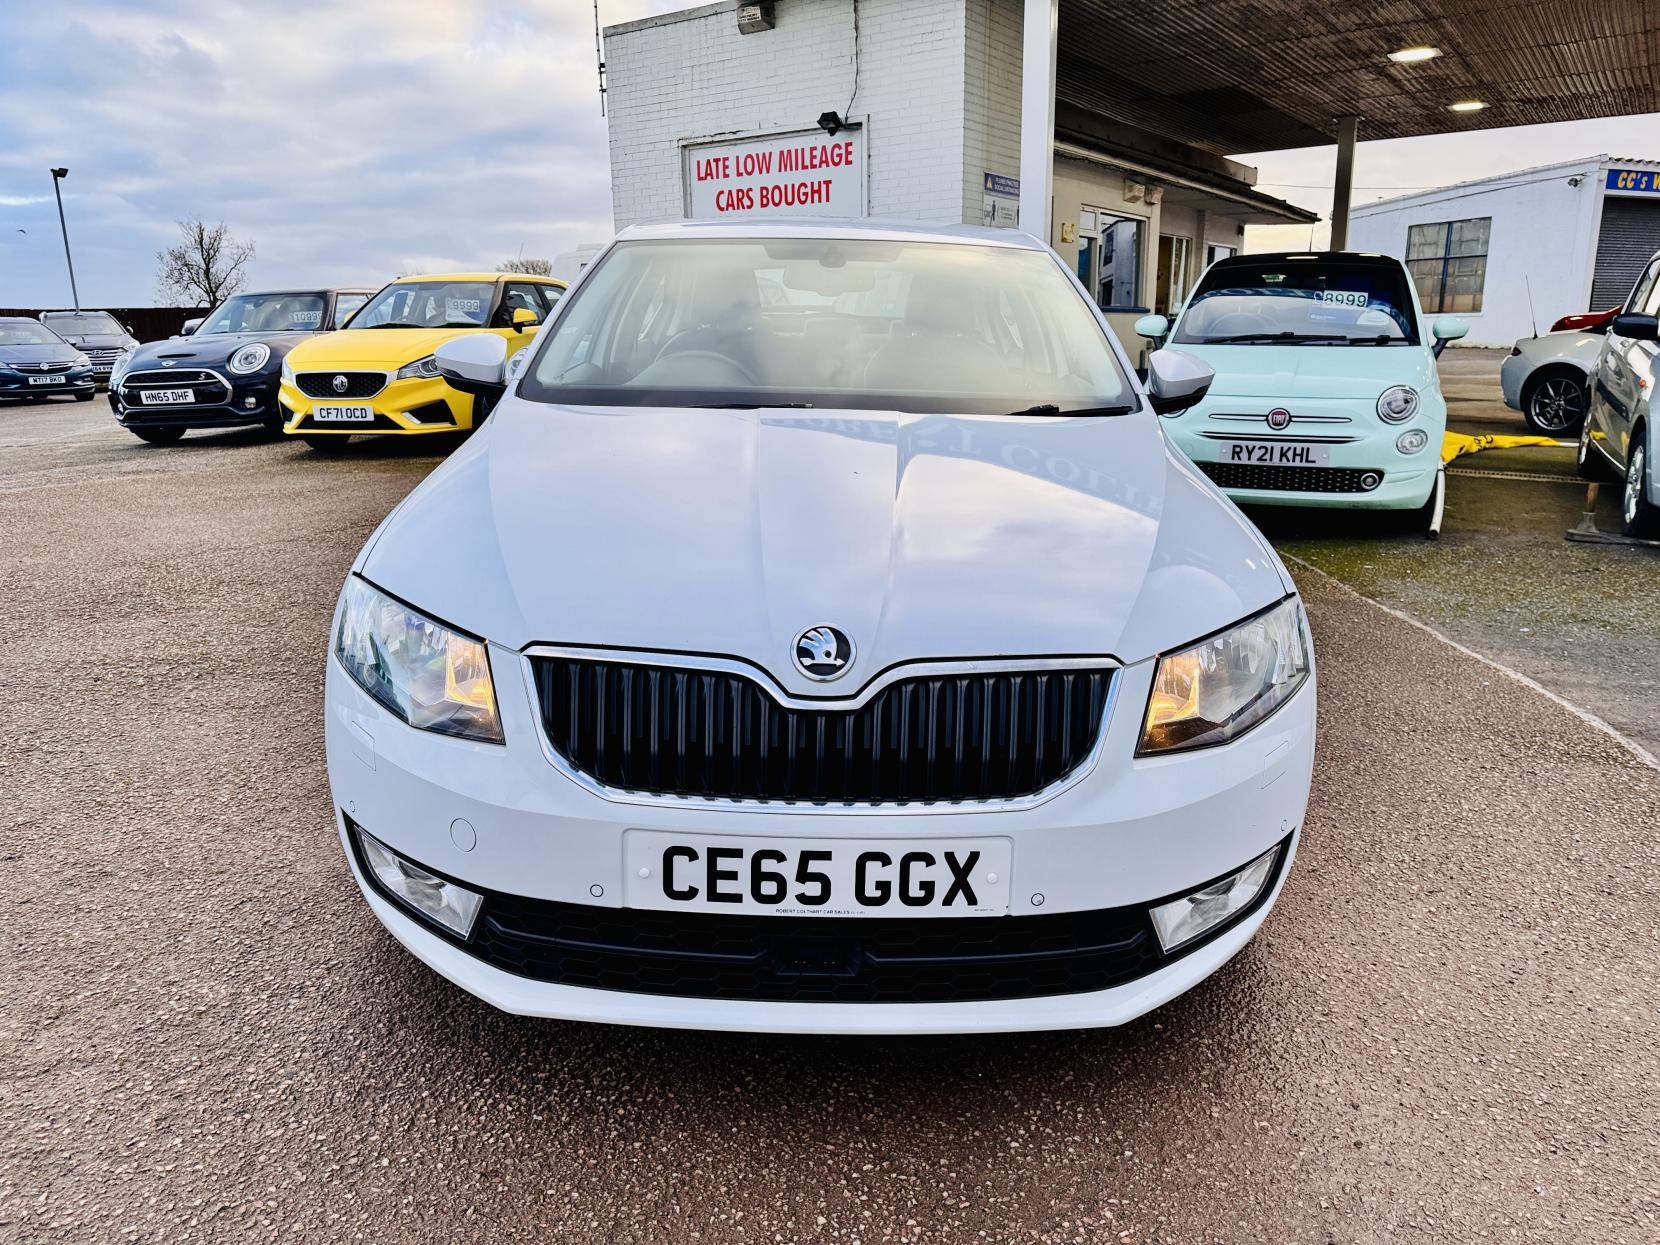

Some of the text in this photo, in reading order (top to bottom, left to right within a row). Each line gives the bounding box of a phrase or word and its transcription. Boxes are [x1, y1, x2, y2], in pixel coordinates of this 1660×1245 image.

[696, 142, 853, 181] LATE LOW MILEAGE
[716, 180, 832, 212] CARS BOUGHT
[144, 390, 190, 403] HN65 DHF
[319, 407, 368, 419] CF71 OCD
[1273, 414, 1287, 425] FIAT
[1231, 444, 1316, 464] RY21 KHL
[662, 845, 981, 907] CE65 GGX
